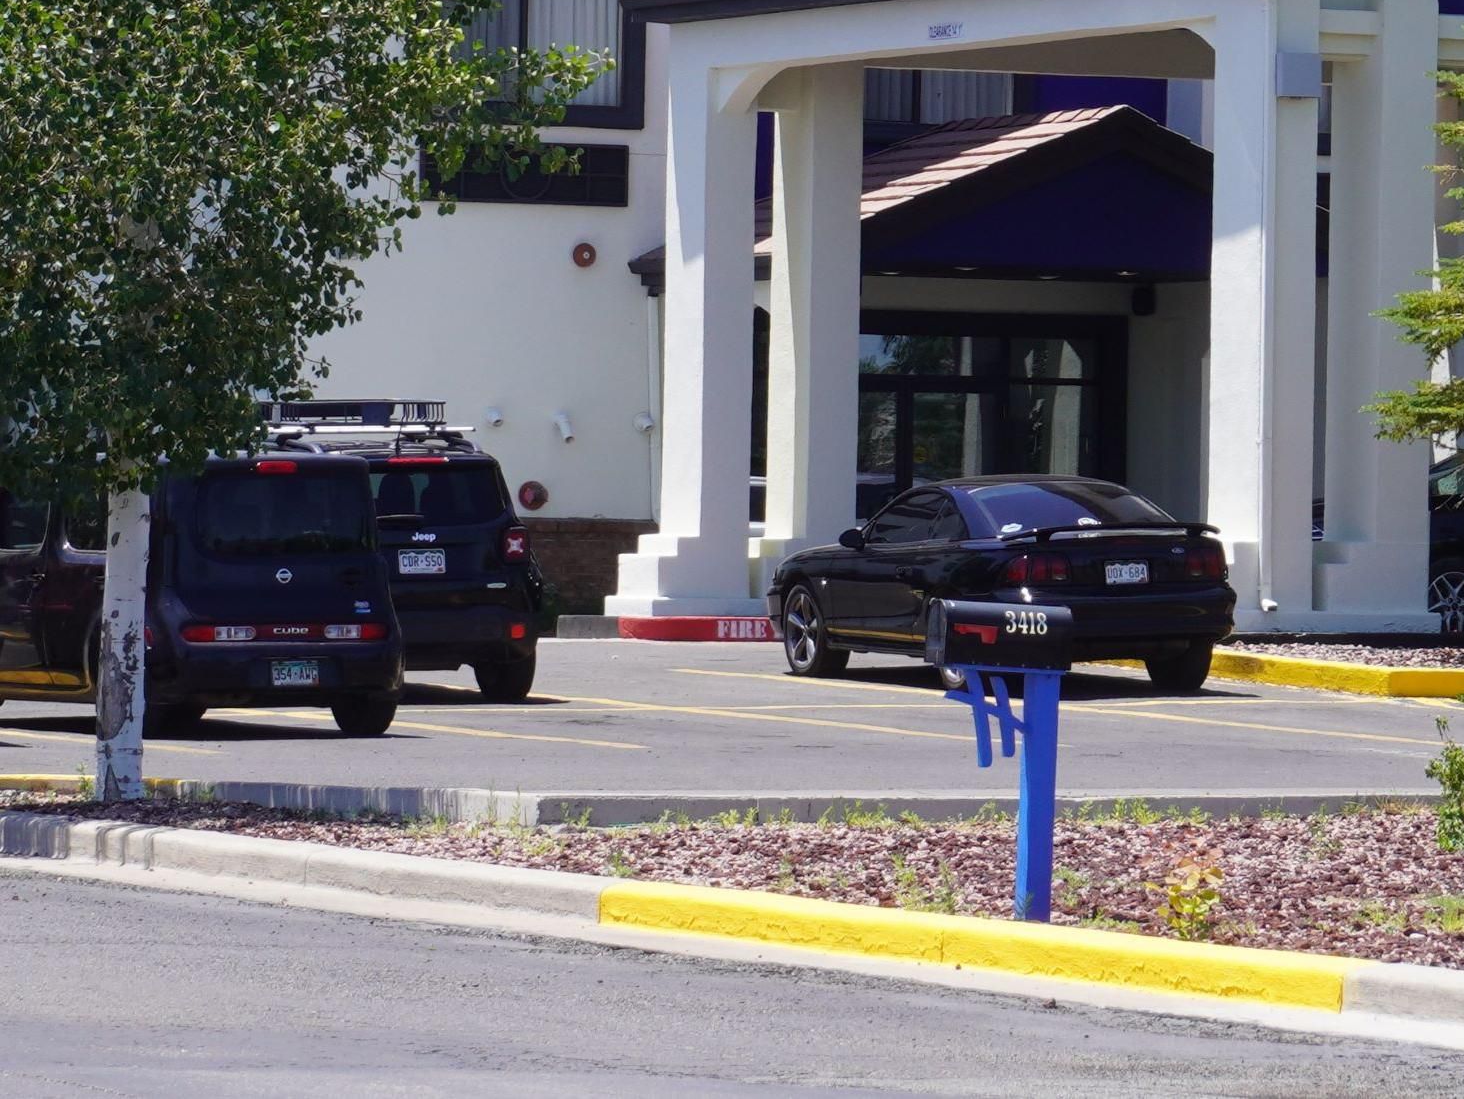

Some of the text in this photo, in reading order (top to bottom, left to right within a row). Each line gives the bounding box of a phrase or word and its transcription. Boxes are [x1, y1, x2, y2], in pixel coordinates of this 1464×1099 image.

[411, 531, 436, 543] Jeep
[717, 620, 767, 639] FIRE
[1005, 610, 1048, 635] 3418
[272, 626, 310, 635] cube
